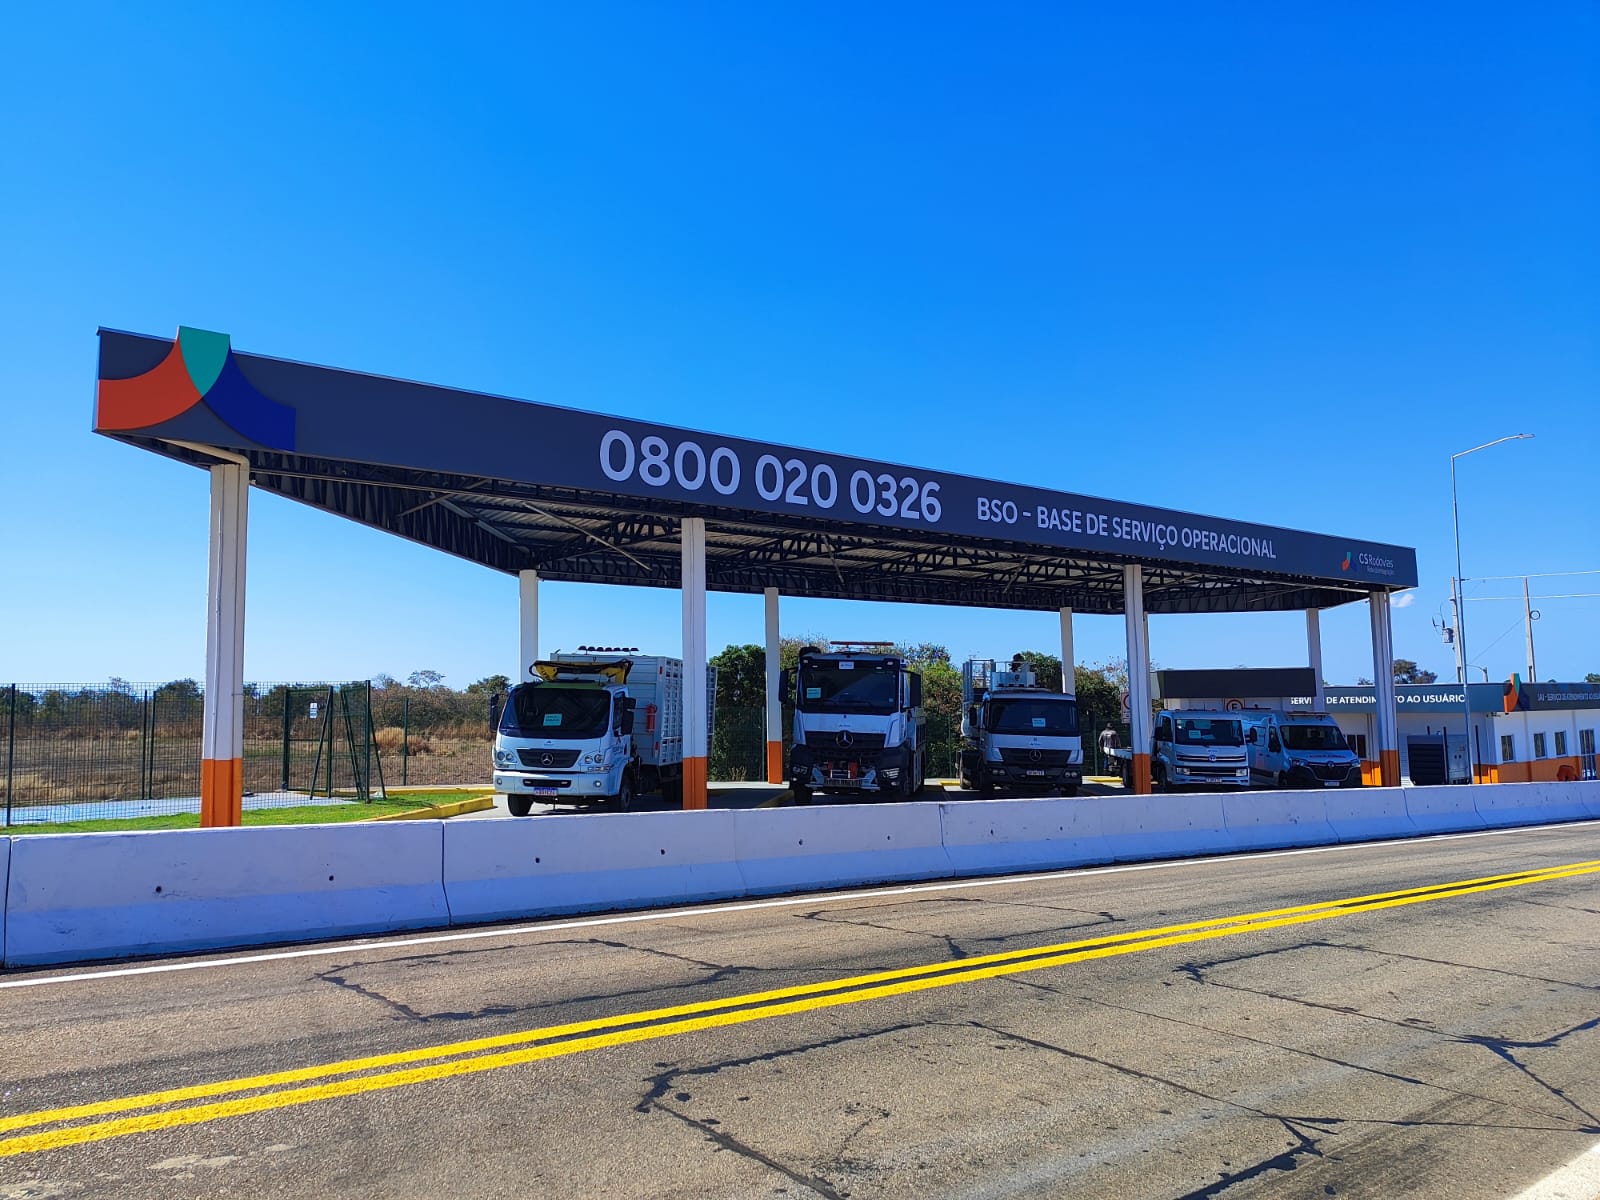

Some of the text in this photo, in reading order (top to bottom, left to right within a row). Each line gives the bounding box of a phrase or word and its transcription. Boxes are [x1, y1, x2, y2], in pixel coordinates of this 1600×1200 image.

[600, 430, 942, 523] 0800 020 0326
[976, 496, 1018, 524] BSO
[1037, 506, 1082, 533] BASE
[1086, 513, 1109, 537] DE
[1112, 517, 1178, 550] SERVIÇO
[1181, 527, 1277, 559] OPERACIONAL
[1326, 696, 1338, 704] DE
[1406, 695, 1421, 704] AO
